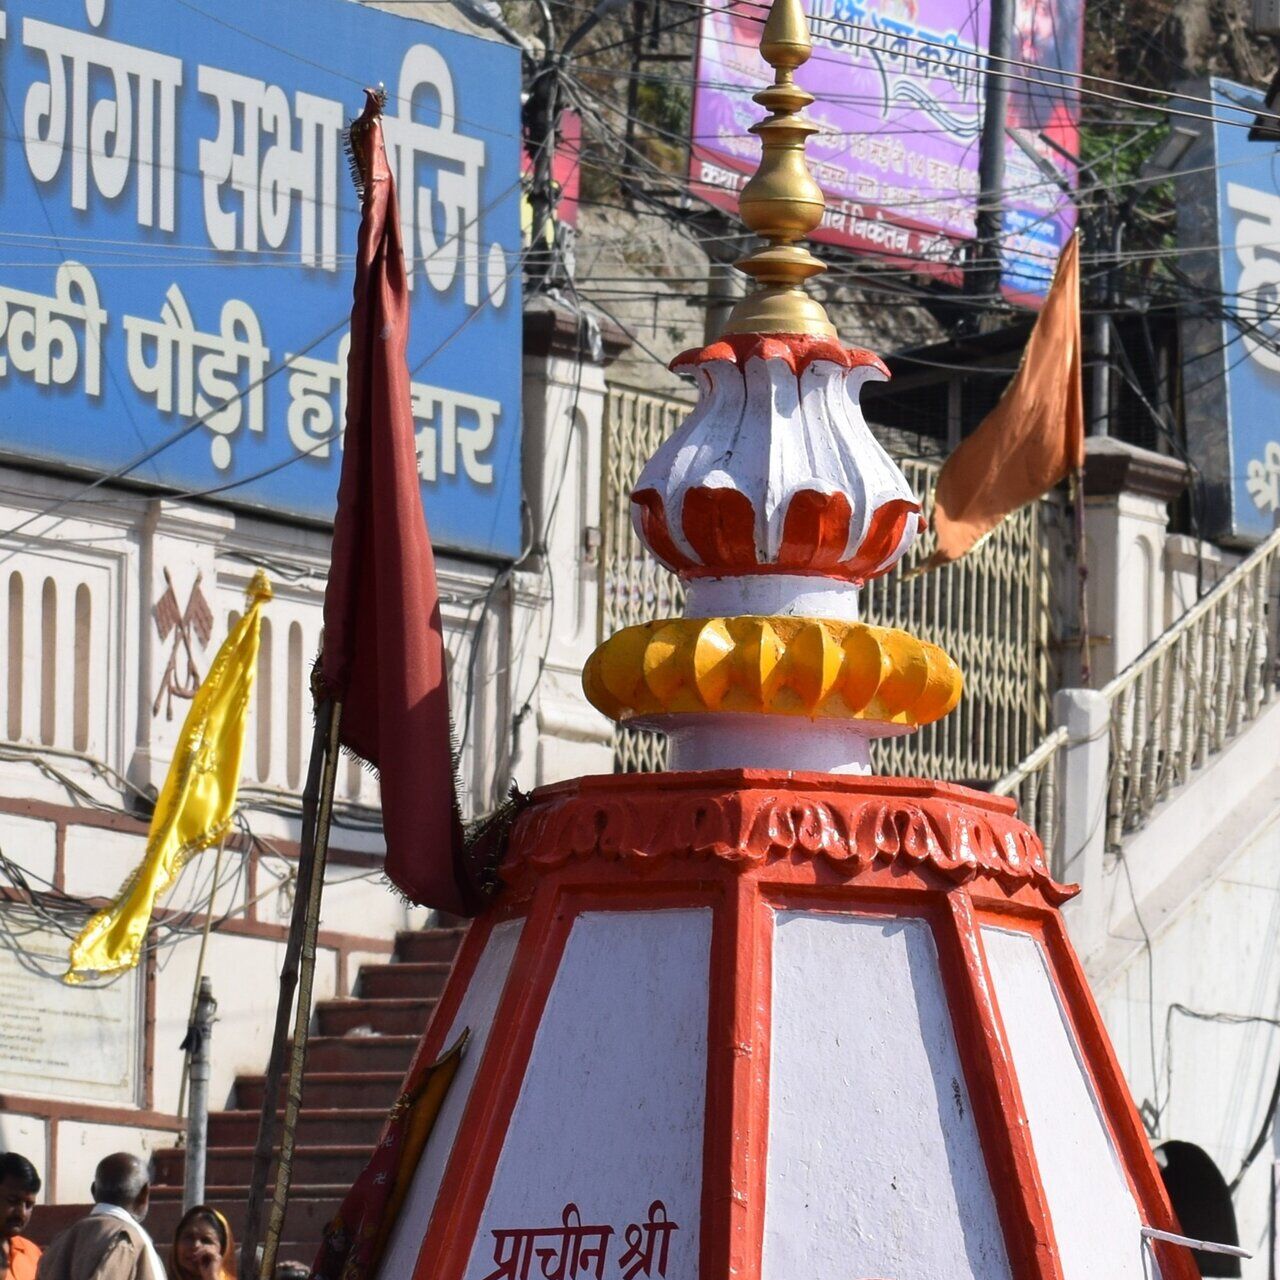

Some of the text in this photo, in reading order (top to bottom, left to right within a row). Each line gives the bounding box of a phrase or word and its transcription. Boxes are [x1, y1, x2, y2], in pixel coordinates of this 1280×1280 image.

[22, 0, 182, 232] गंगा
[198, 64, 343, 272] सभा
[123, 283, 270, 470] पौड़ी
